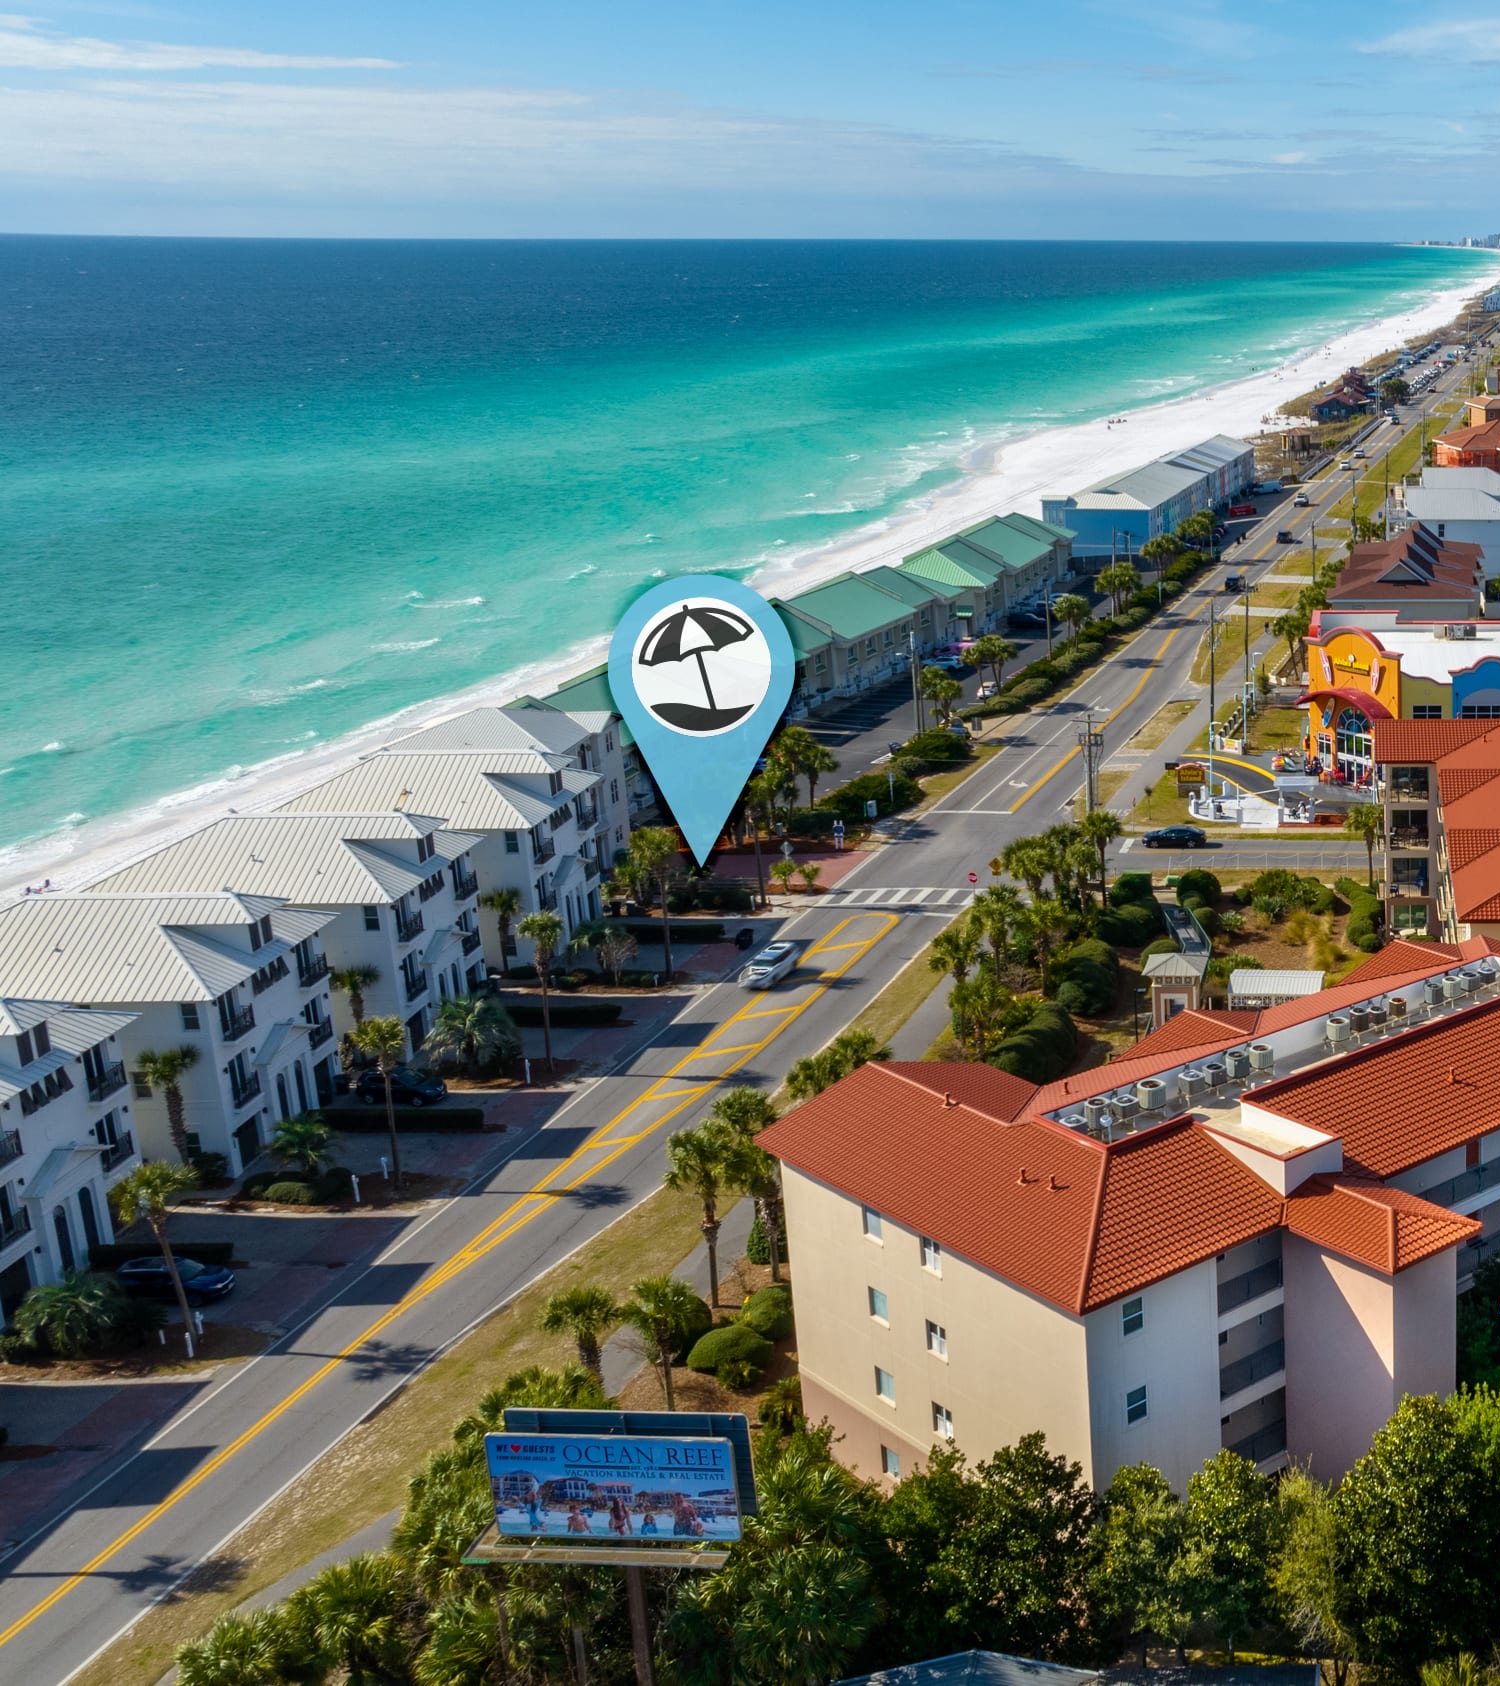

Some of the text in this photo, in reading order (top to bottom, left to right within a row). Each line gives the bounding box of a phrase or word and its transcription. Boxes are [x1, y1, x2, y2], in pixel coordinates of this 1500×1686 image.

[496, 1444, 555, 1454] WE GUESTS
[562, 1444, 724, 1466] OCEAN REEF
[565, 1469, 612, 1478] VACATION
[616, 1470, 656, 1479] RENTALS
[670, 1472, 690, 1480] REAL
[693, 1472, 726, 1481] ESTATE
